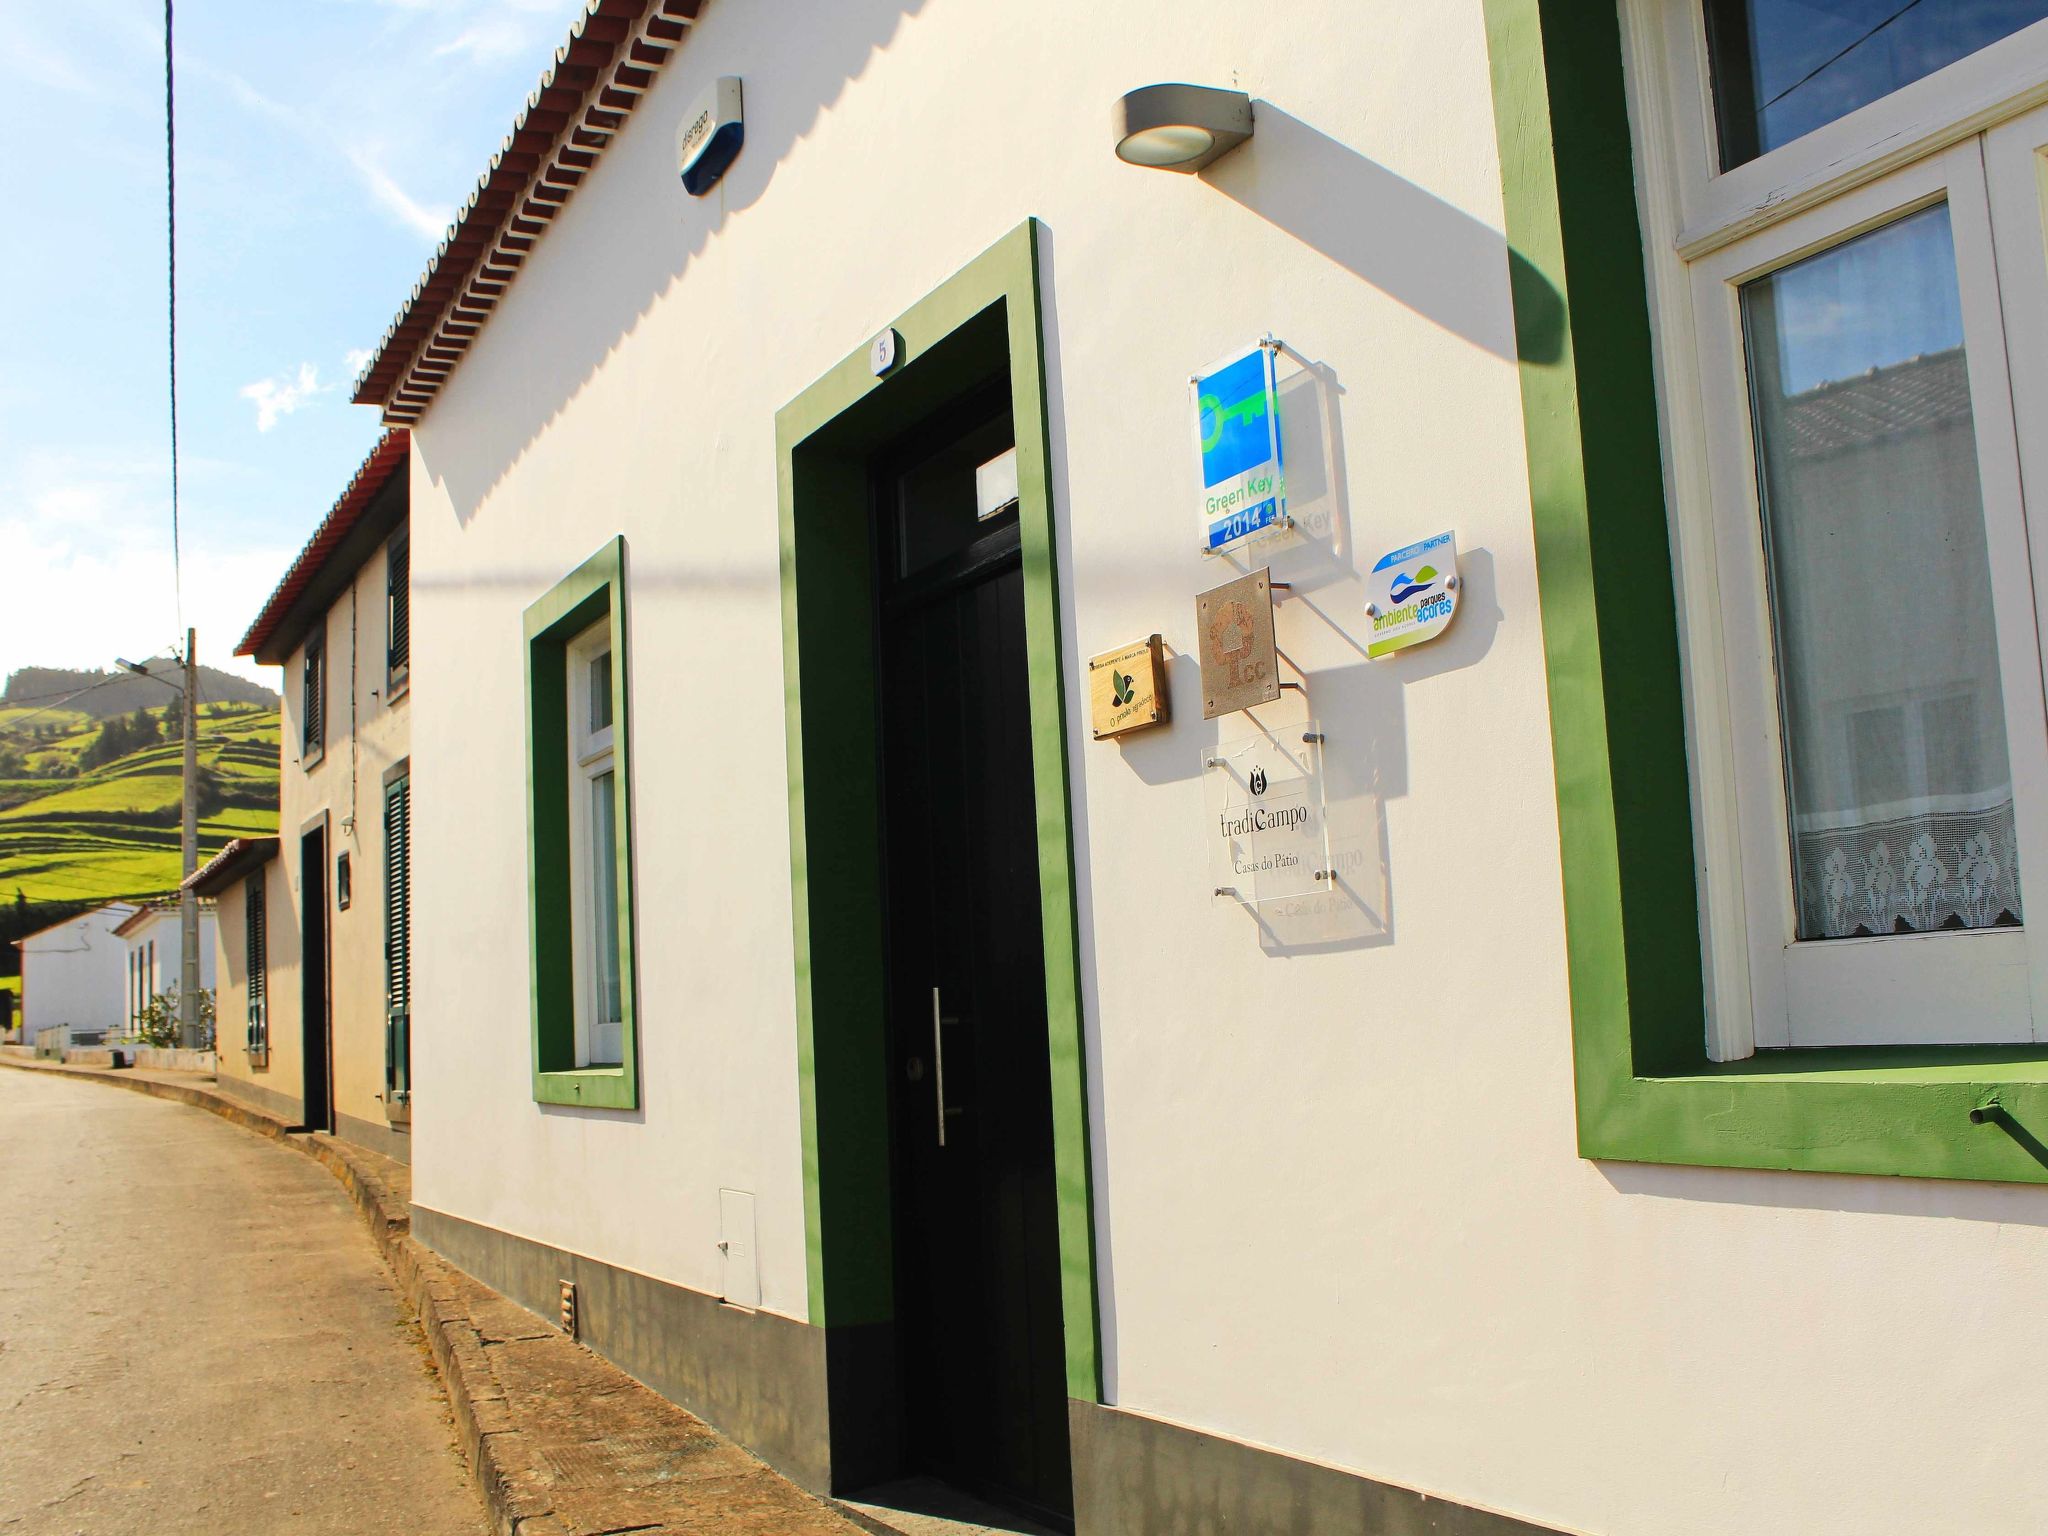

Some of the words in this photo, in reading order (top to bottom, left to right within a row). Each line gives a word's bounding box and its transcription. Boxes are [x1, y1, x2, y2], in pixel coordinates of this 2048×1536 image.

[879, 338, 887, 362] 5
[1206, 487, 1244, 515] Green
[1246, 475, 1273, 497] Key
[1223, 507, 1261, 541] 2014
[1423, 534, 1451, 551] PARTNER
[1420, 592, 1446, 609] parques
[1373, 604, 1418, 631] ambiente
[1416, 599, 1452, 623] açores
[1220, 804, 1307, 837] tradiCampo
[1234, 859, 1259, 875] Casas
[1261, 856, 1273, 870] do
[1274, 852, 1298, 868] Pátio
